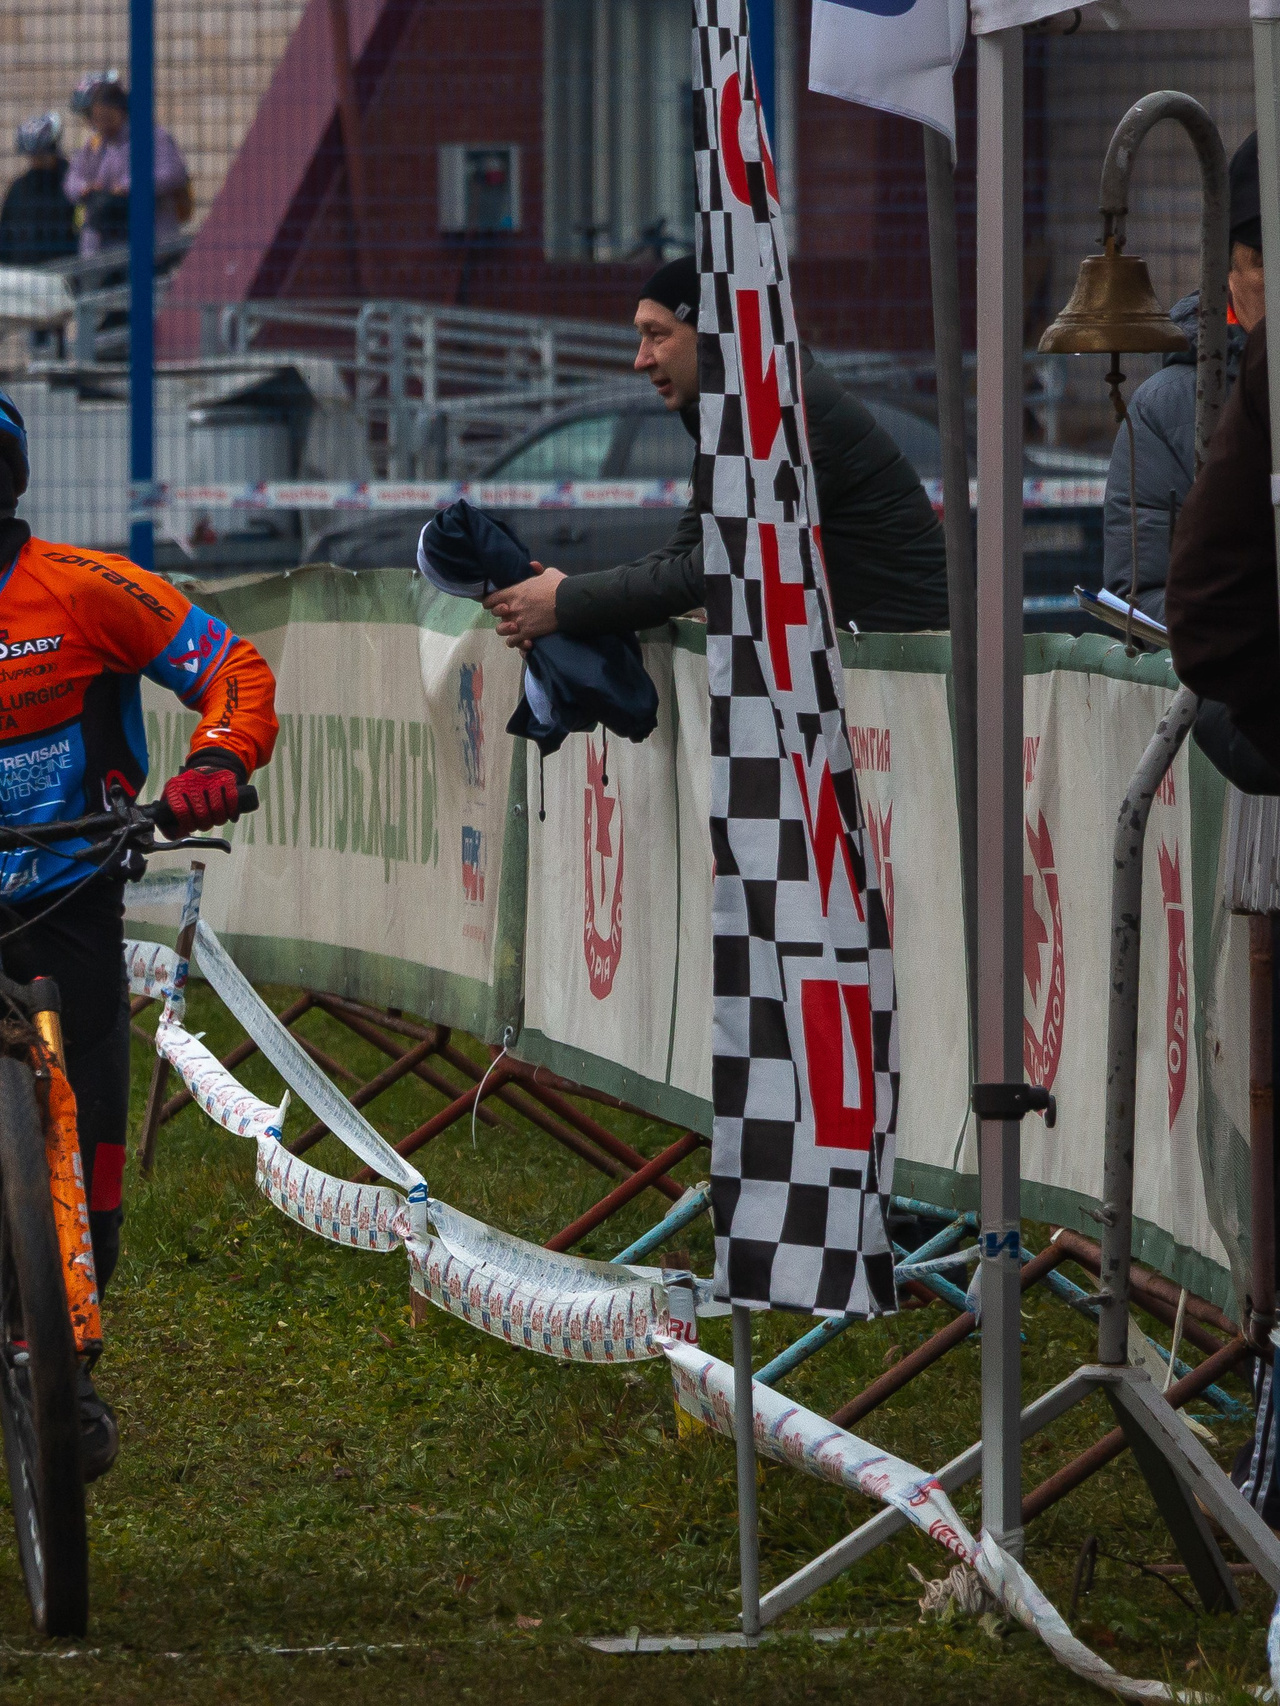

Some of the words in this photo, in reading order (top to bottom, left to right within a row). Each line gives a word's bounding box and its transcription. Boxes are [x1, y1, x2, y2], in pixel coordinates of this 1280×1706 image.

[41, 552, 177, 622] corratec
[11, 637, 62, 657] SABY
[0, 773, 61, 802] UTENSILI
